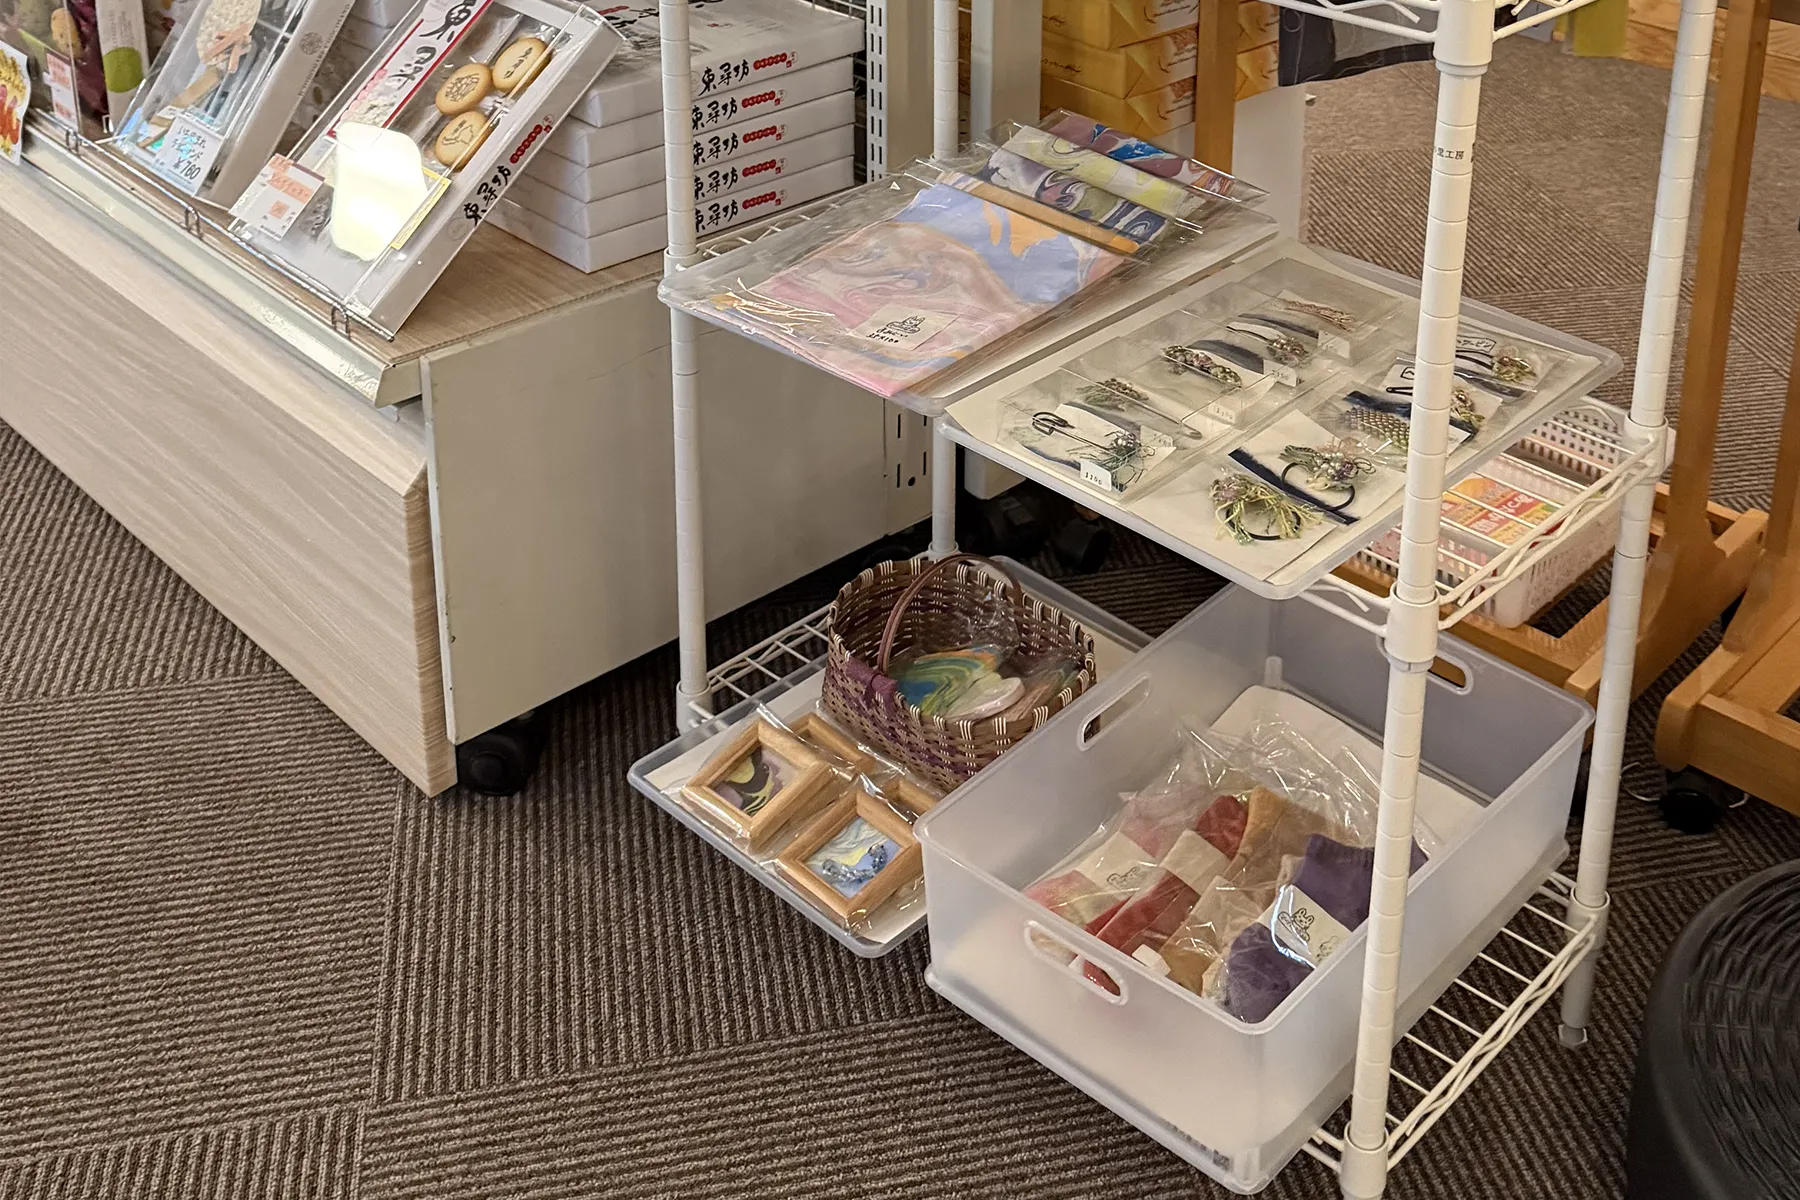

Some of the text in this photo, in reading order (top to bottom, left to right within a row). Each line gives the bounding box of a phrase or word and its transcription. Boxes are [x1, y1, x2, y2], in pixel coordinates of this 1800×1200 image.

[698, 58, 749, 96] 東尋坊
[692, 97, 738, 131] 東尋坊
[693, 132, 739, 166] 東尋坊
[464, 165, 511, 228] 東尋坊
[694, 167, 739, 200] 東尋坊
[695, 199, 739, 232] 東尋坊
